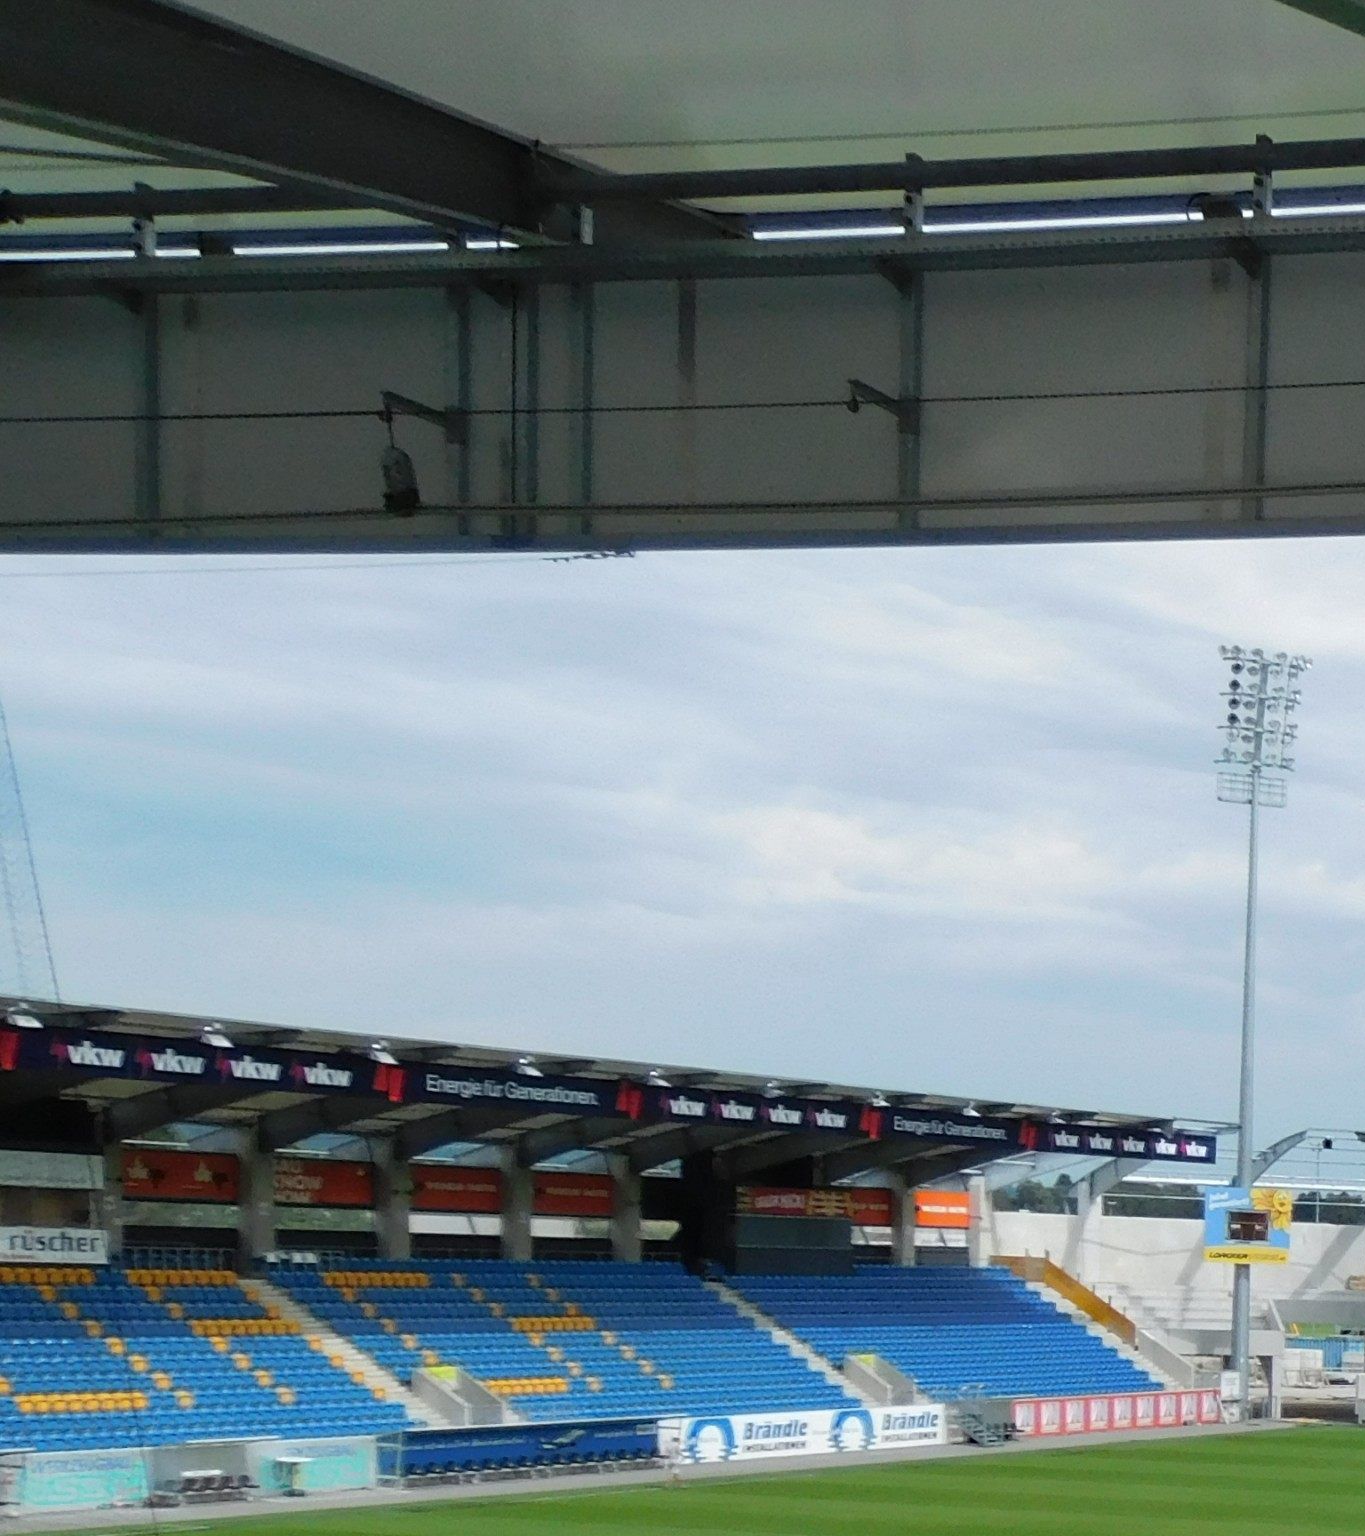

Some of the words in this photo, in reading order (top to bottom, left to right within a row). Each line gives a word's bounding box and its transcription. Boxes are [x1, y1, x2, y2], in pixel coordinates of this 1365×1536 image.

[67, 1041, 124, 1067] vkw
[151, 1049, 206, 1074] vkw
[230, 1056, 281, 1080] vkw
[303, 1063, 352, 1087] vkw
[425, 1074, 482, 1098] Energie
[8, 1229, 100, 1252] rüscher
[743, 1419, 808, 1440] Brändle
[881, 1411, 939, 1430] Brändle
